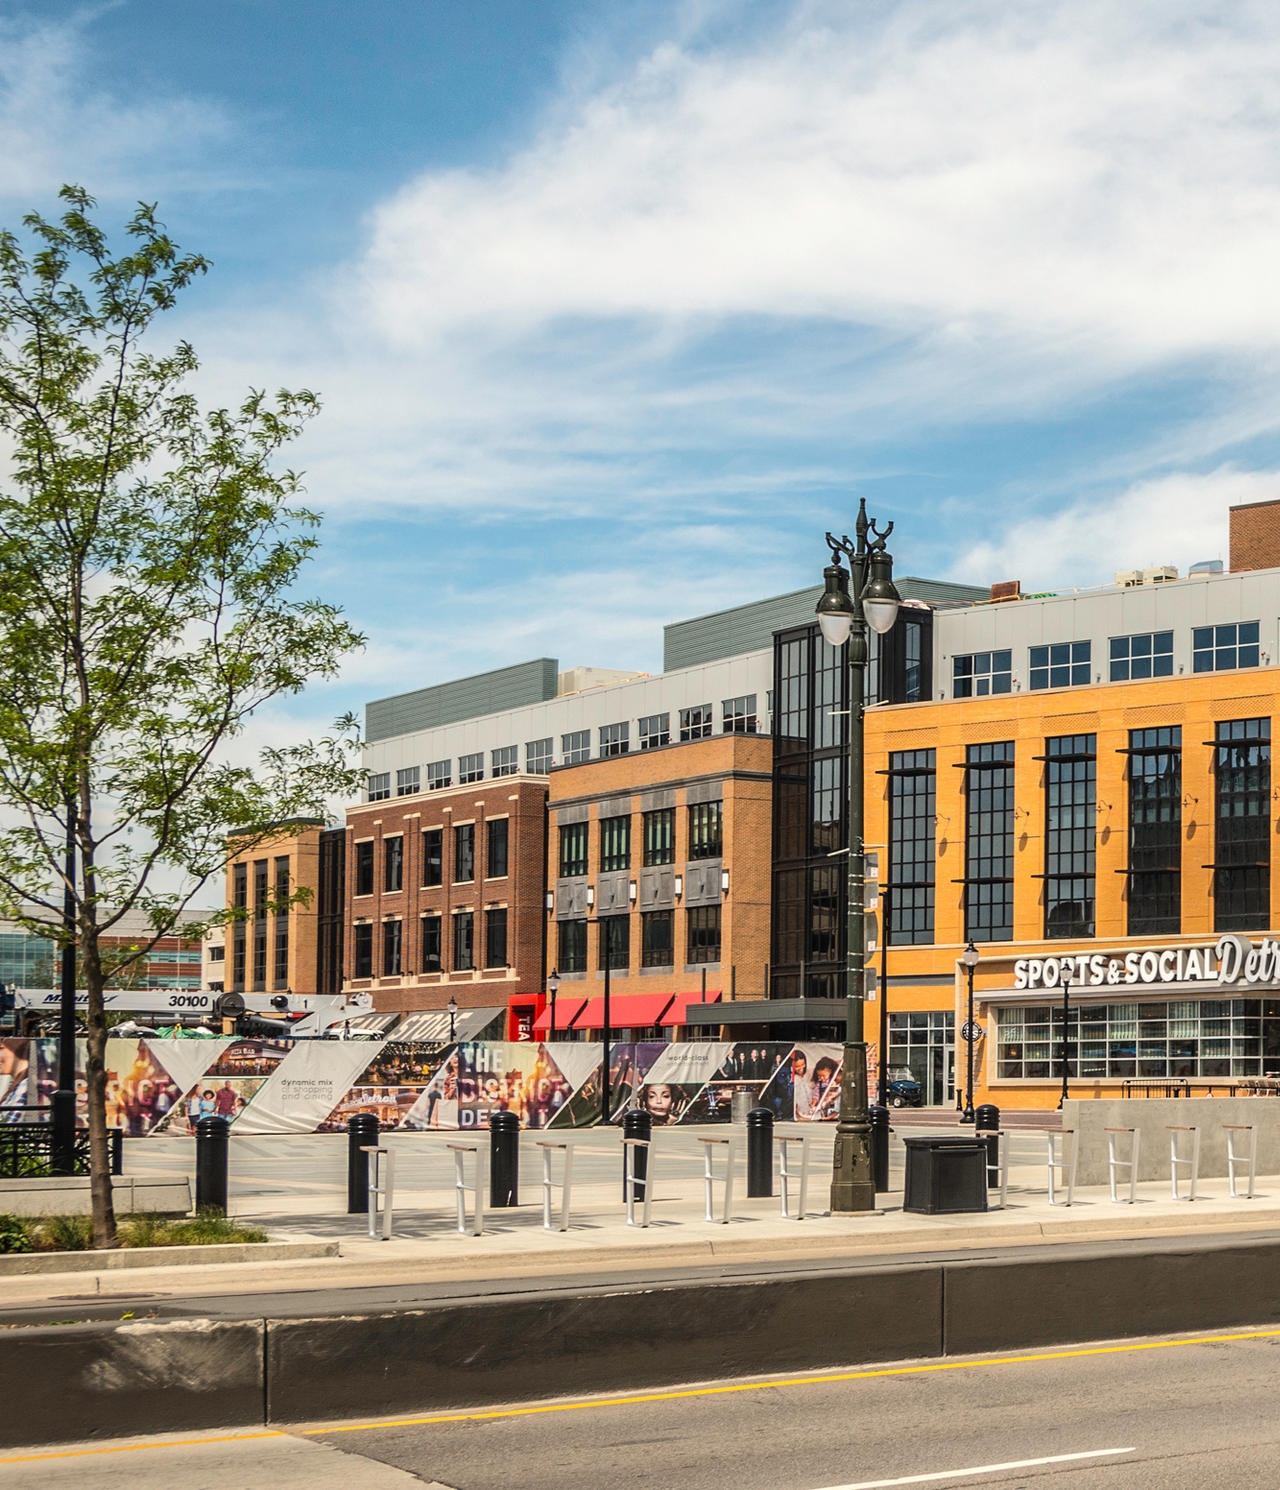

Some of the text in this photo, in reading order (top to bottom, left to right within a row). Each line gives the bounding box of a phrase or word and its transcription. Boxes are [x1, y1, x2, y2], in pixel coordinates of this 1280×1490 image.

[1124, 949, 1219, 984] SOCIAL
[168, 995, 209, 1008] 30100
[462, 1047, 504, 1073] THE
[281, 1079, 316, 1087] dynamic
[461, 1077, 563, 1104] DISTRICT
